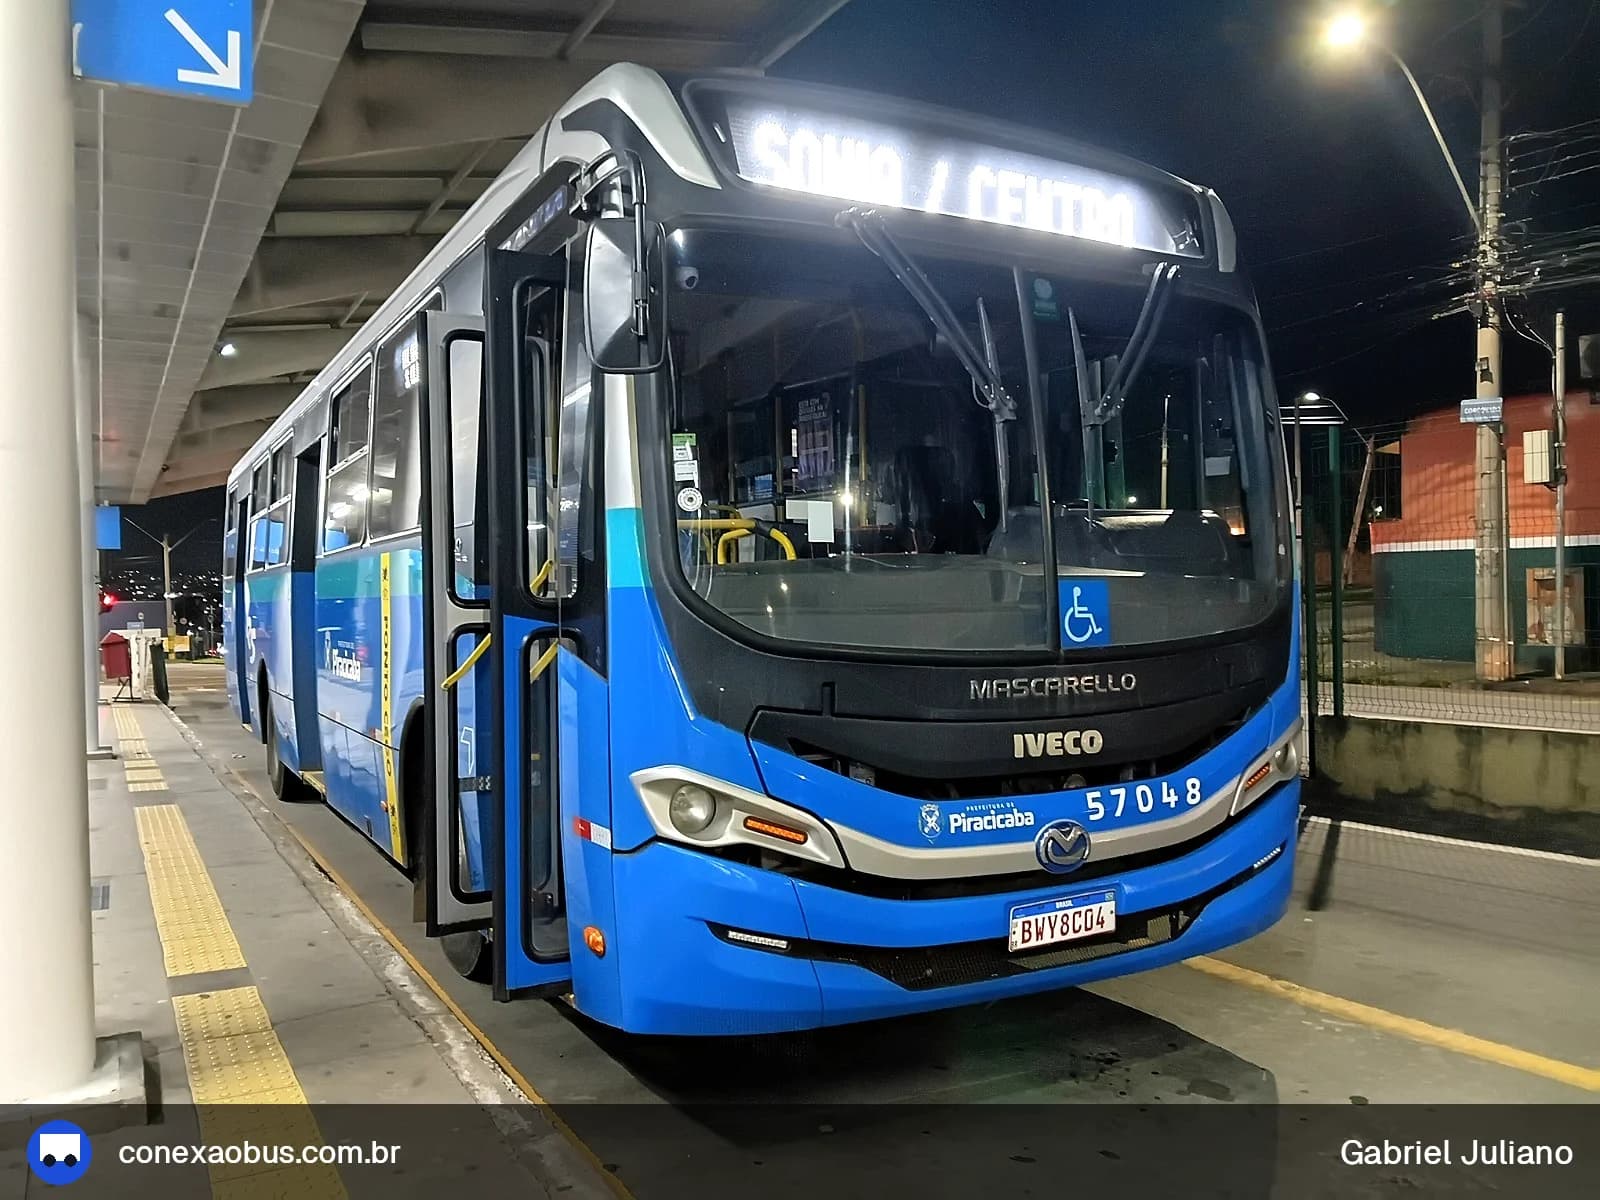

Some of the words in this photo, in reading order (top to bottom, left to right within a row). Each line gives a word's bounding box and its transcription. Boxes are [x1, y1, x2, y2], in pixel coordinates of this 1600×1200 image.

[967, 163, 1137, 246] CENTRO
[970, 673, 1137, 700] MASCARELLO
[1013, 729, 1104, 758] IVECO
[1086, 777, 1202, 822] 57048
[949, 808, 1035, 834] Piracicaba
[1021, 905, 1105, 945] BWY8C04
